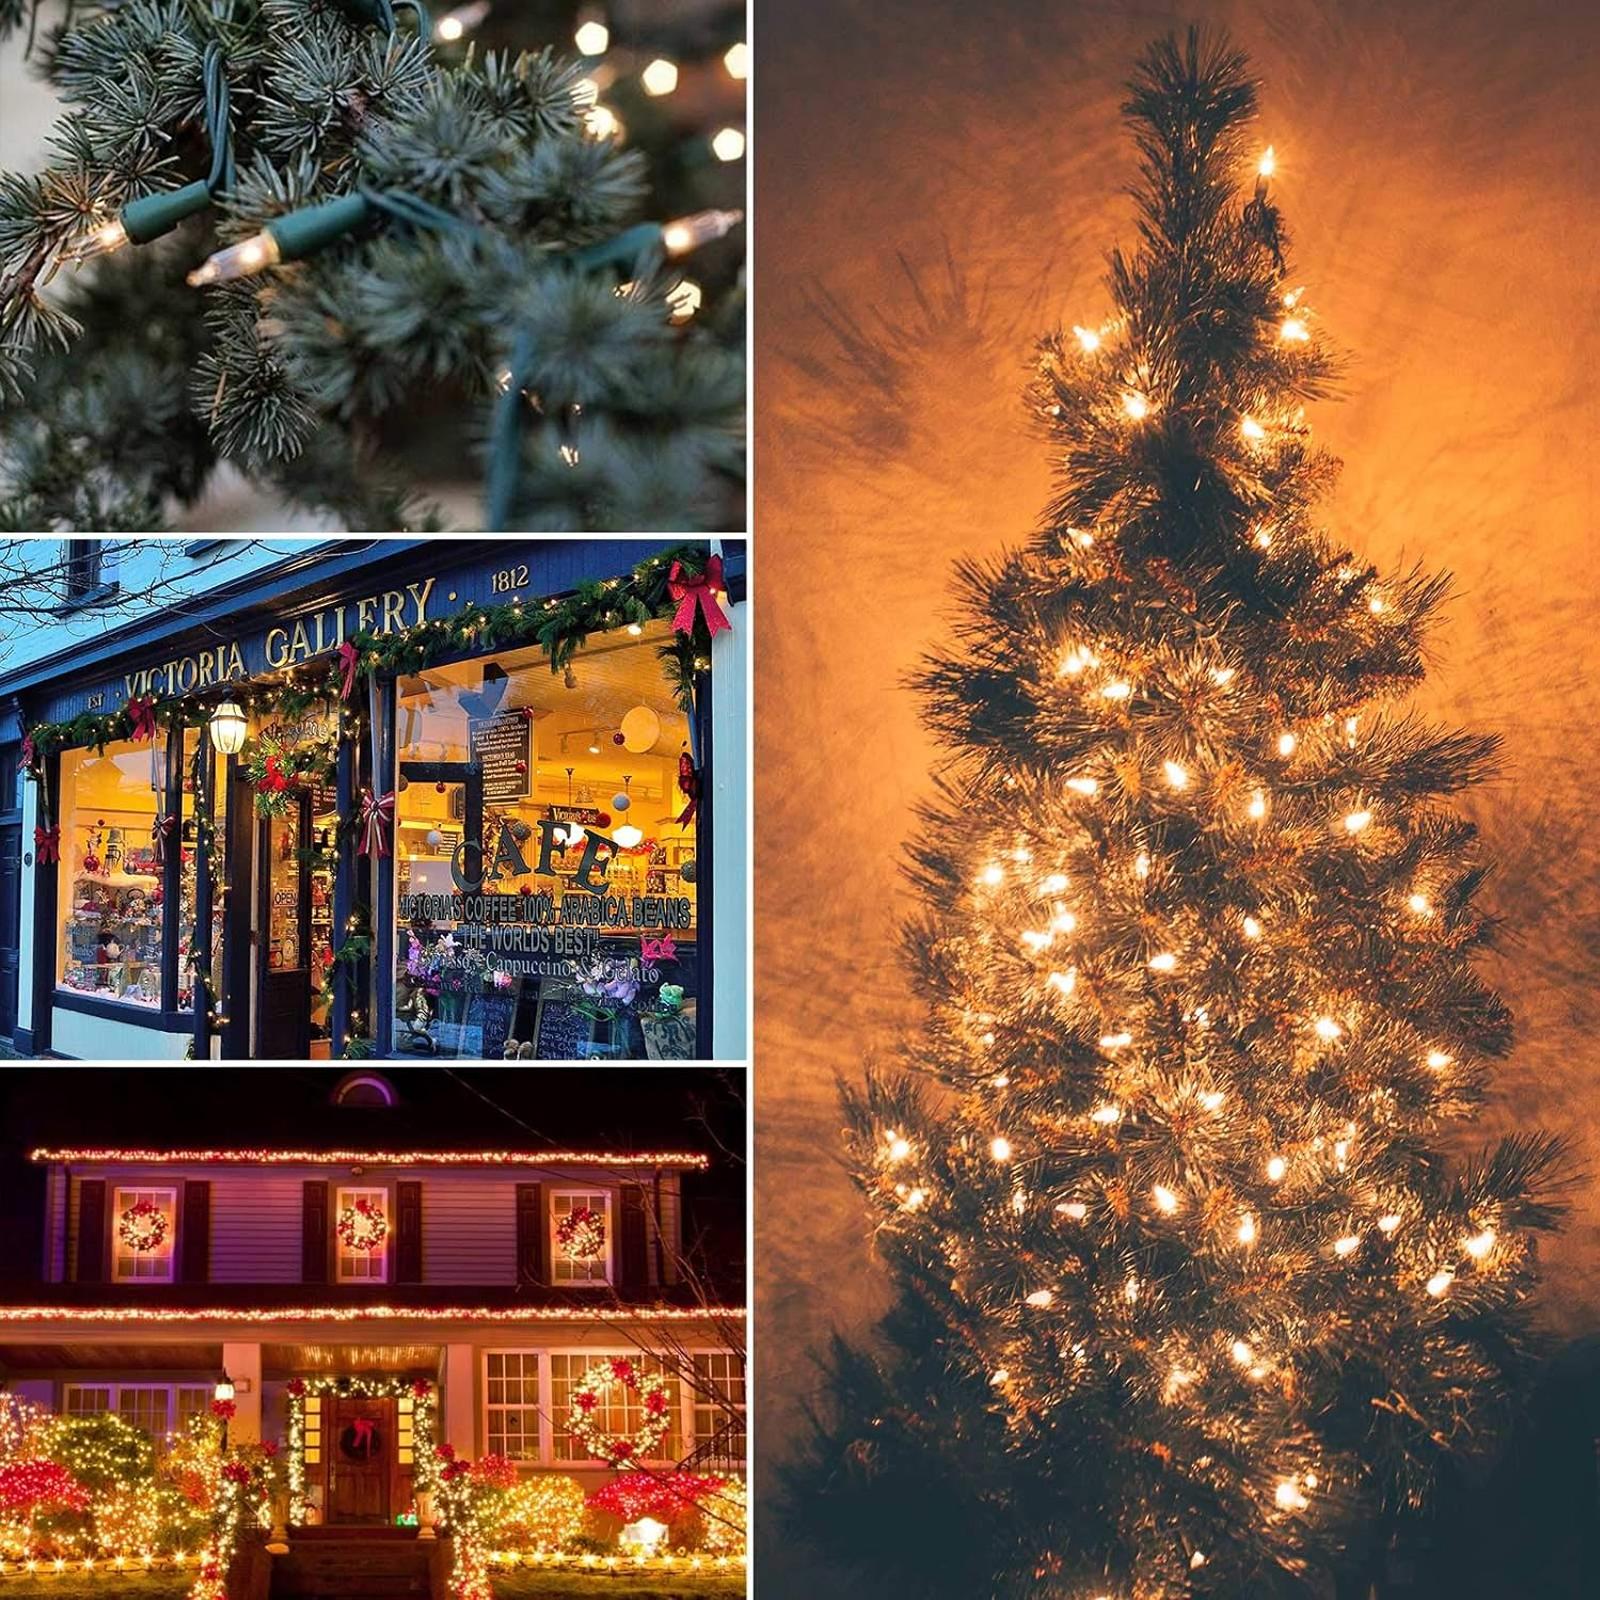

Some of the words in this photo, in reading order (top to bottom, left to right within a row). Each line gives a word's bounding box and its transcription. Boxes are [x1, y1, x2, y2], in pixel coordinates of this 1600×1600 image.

[125, 641, 248, 699] VICTORIA
[265, 577, 436, 669] GALLERY
[491, 565, 530, 594] 1812
[451, 820, 619, 895] CAFE
[464, 896, 516, 922] COFFEE
[522, 897, 556, 924] 100%
[560, 896, 629, 927] ARABICA
[632, 897, 691, 928] BEANS
[490, 926, 550, 954] WORLDS
[486, 951, 571, 979] Cappuccino
[603, 957, 660, 983] Gelato
